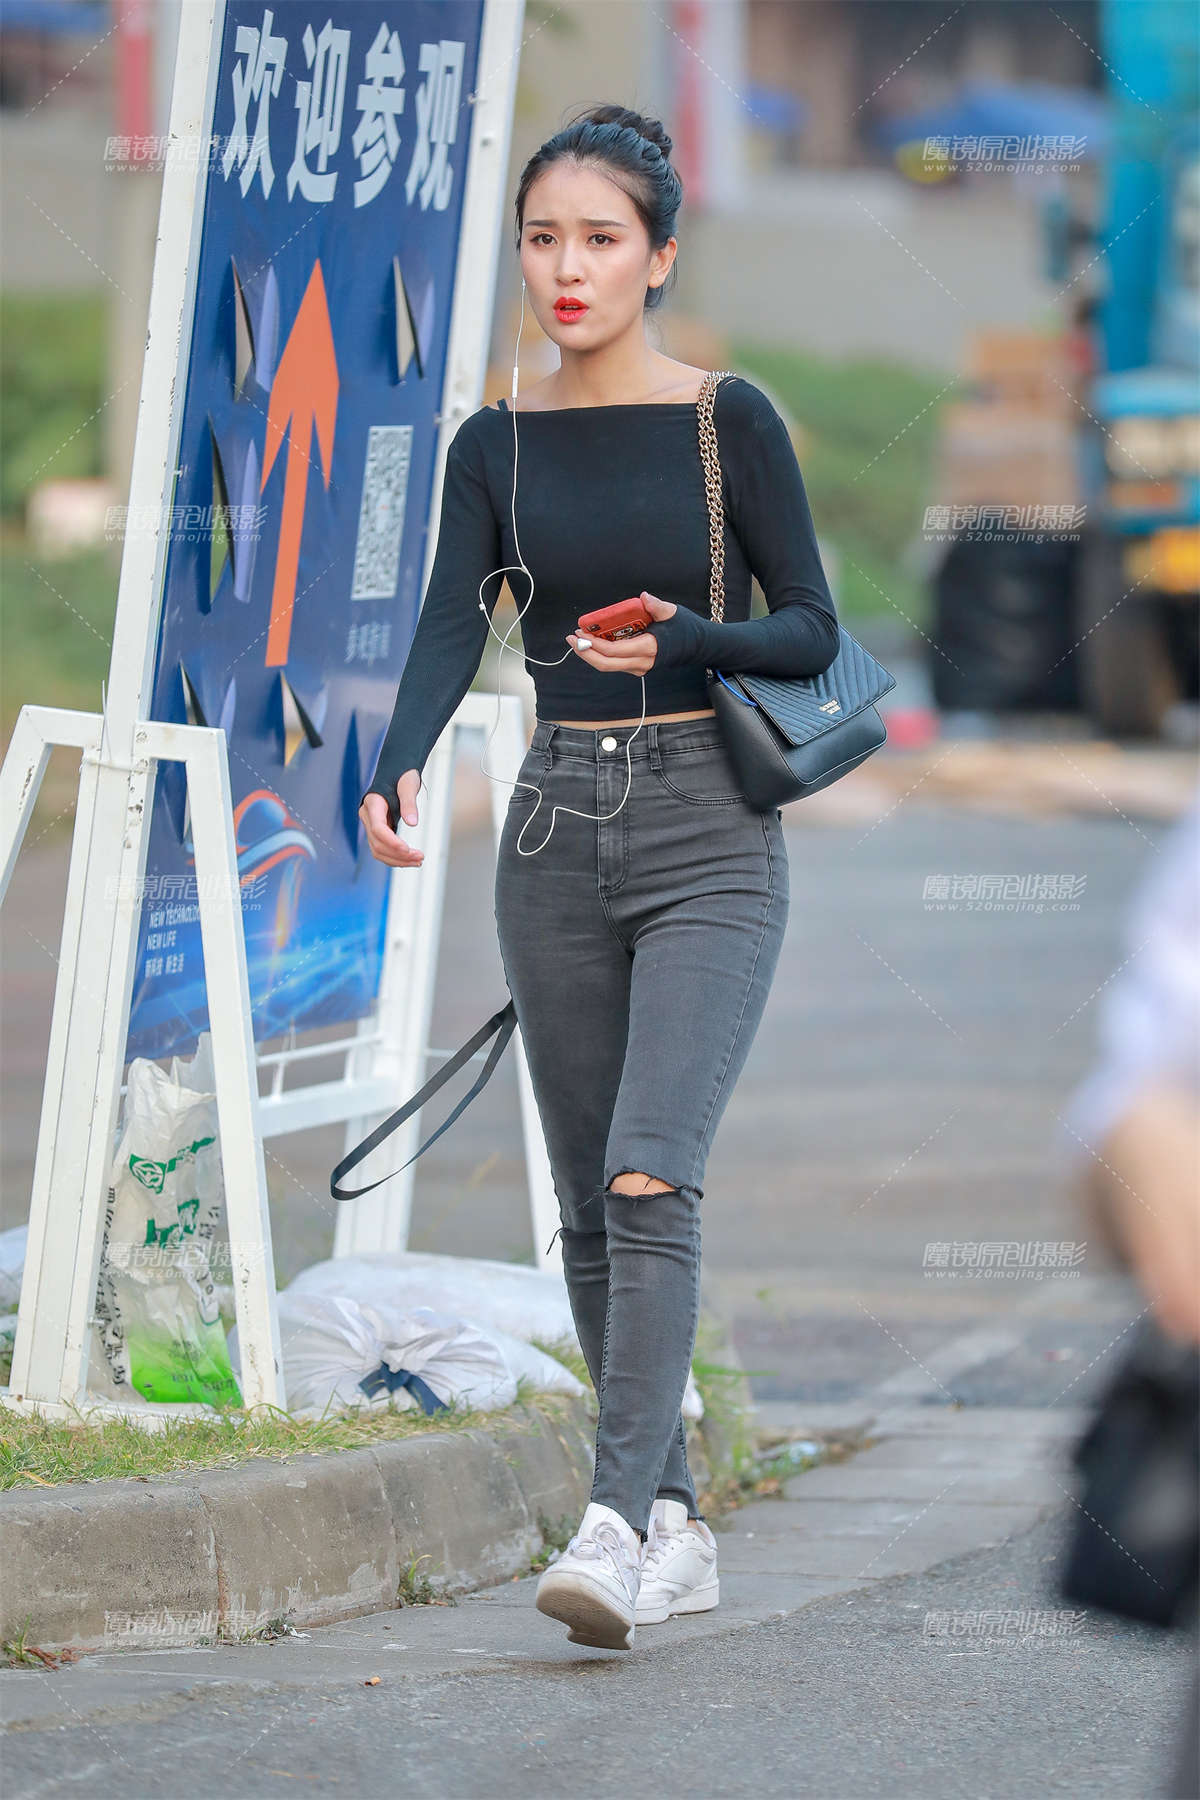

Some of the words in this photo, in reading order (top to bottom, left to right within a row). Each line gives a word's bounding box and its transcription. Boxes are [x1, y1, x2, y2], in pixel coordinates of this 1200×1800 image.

[222, 9, 466, 212] 欢迎参观
[146, 933, 163, 951] NEW
[162, 930, 177, 949] LIFE
